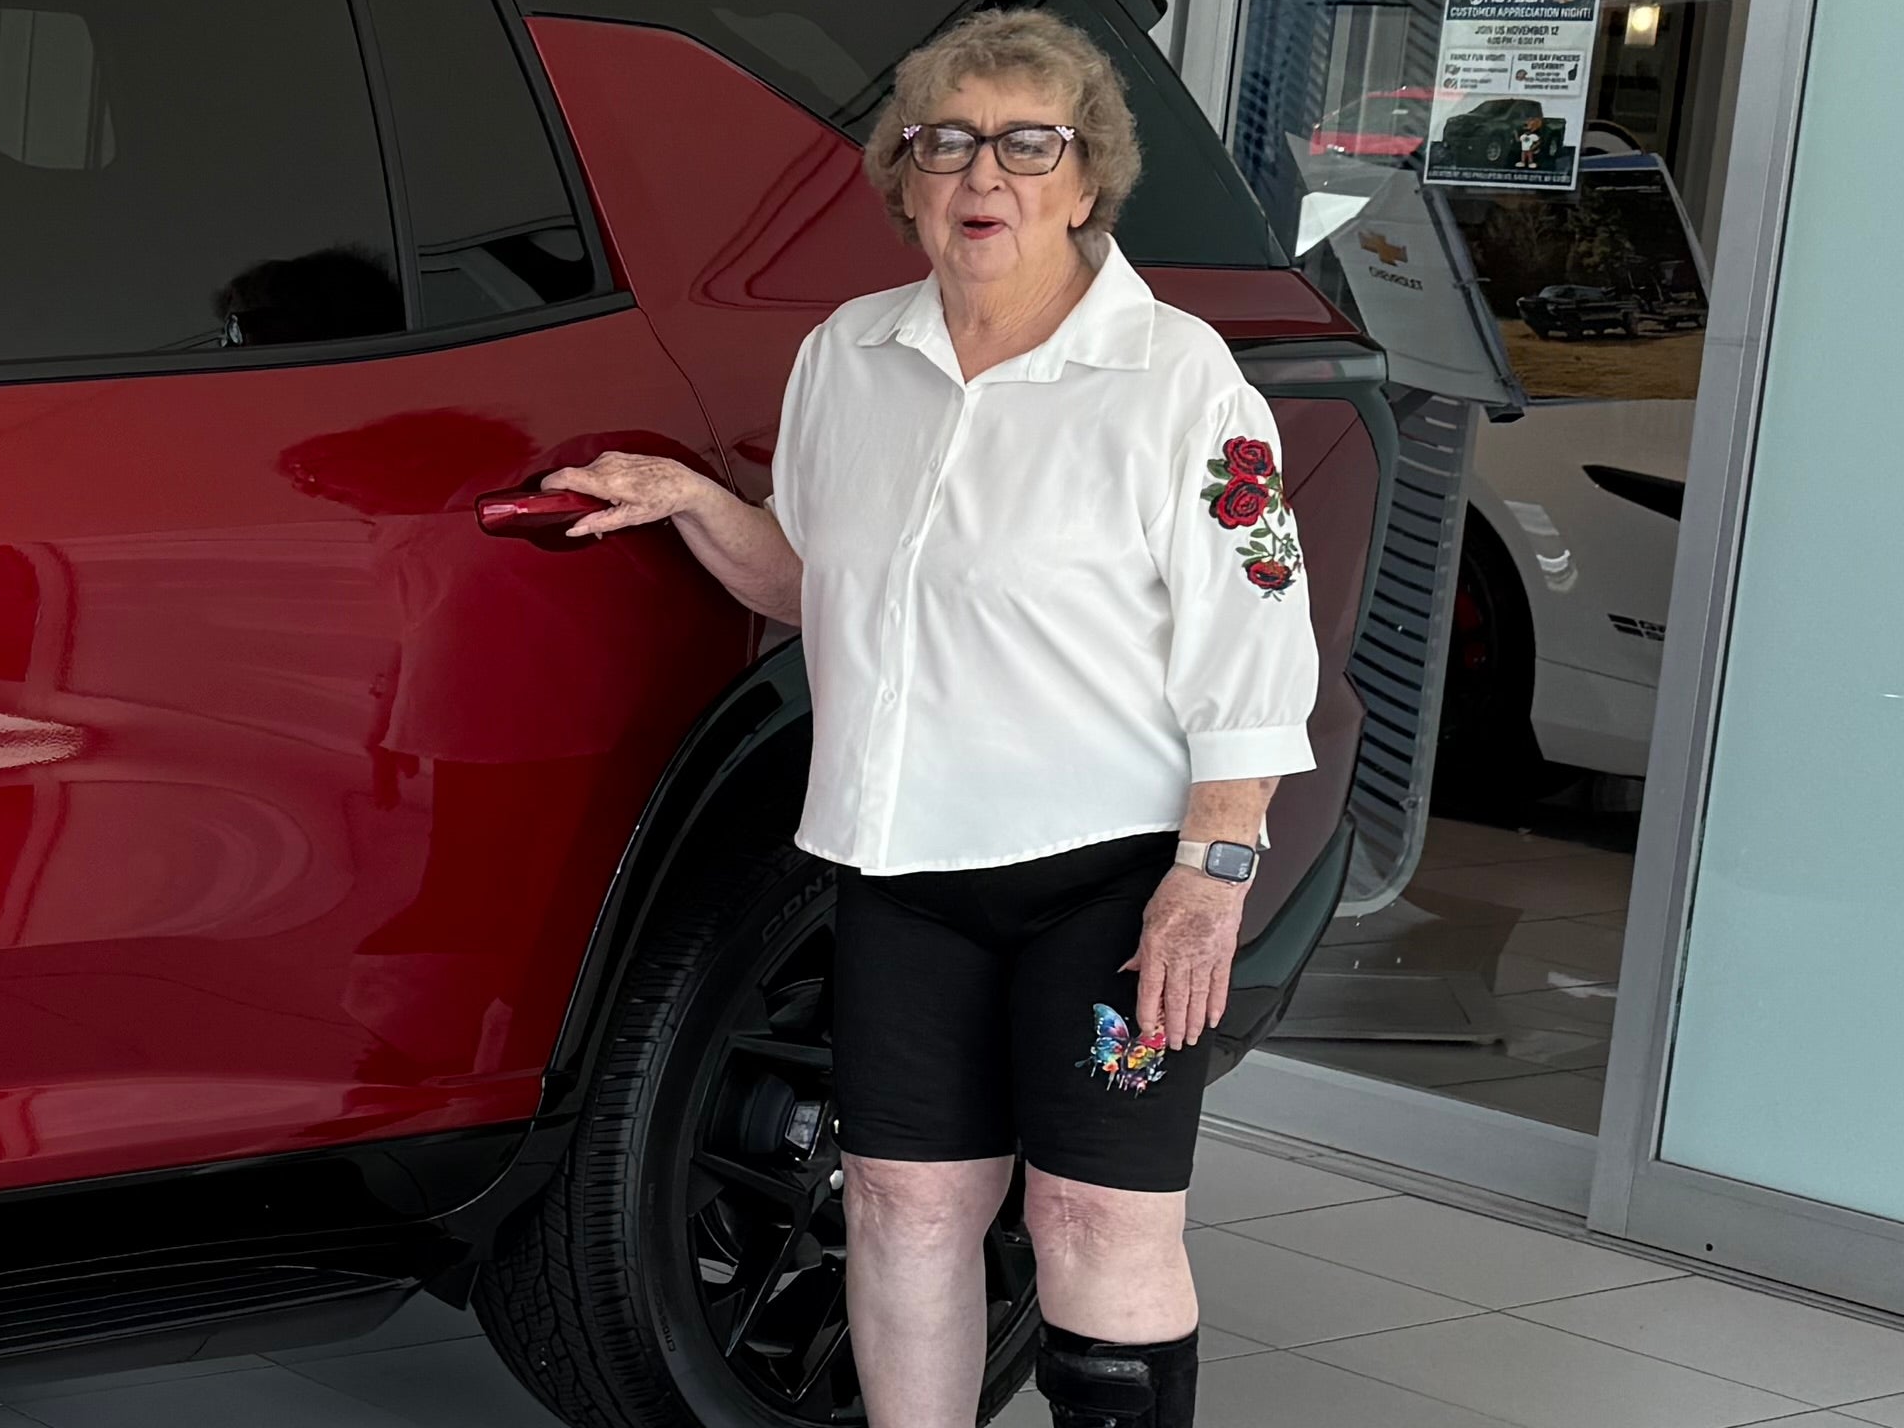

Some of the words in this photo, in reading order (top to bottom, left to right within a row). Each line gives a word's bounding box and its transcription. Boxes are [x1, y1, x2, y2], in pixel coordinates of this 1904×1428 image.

[1450, 6, 1496, 18] CUSTOMER
[1497, 7, 1559, 18] APPRECIATION
[1494, 26, 1505, 35] US
[1506, 26, 1549, 35] NOVEMBER
